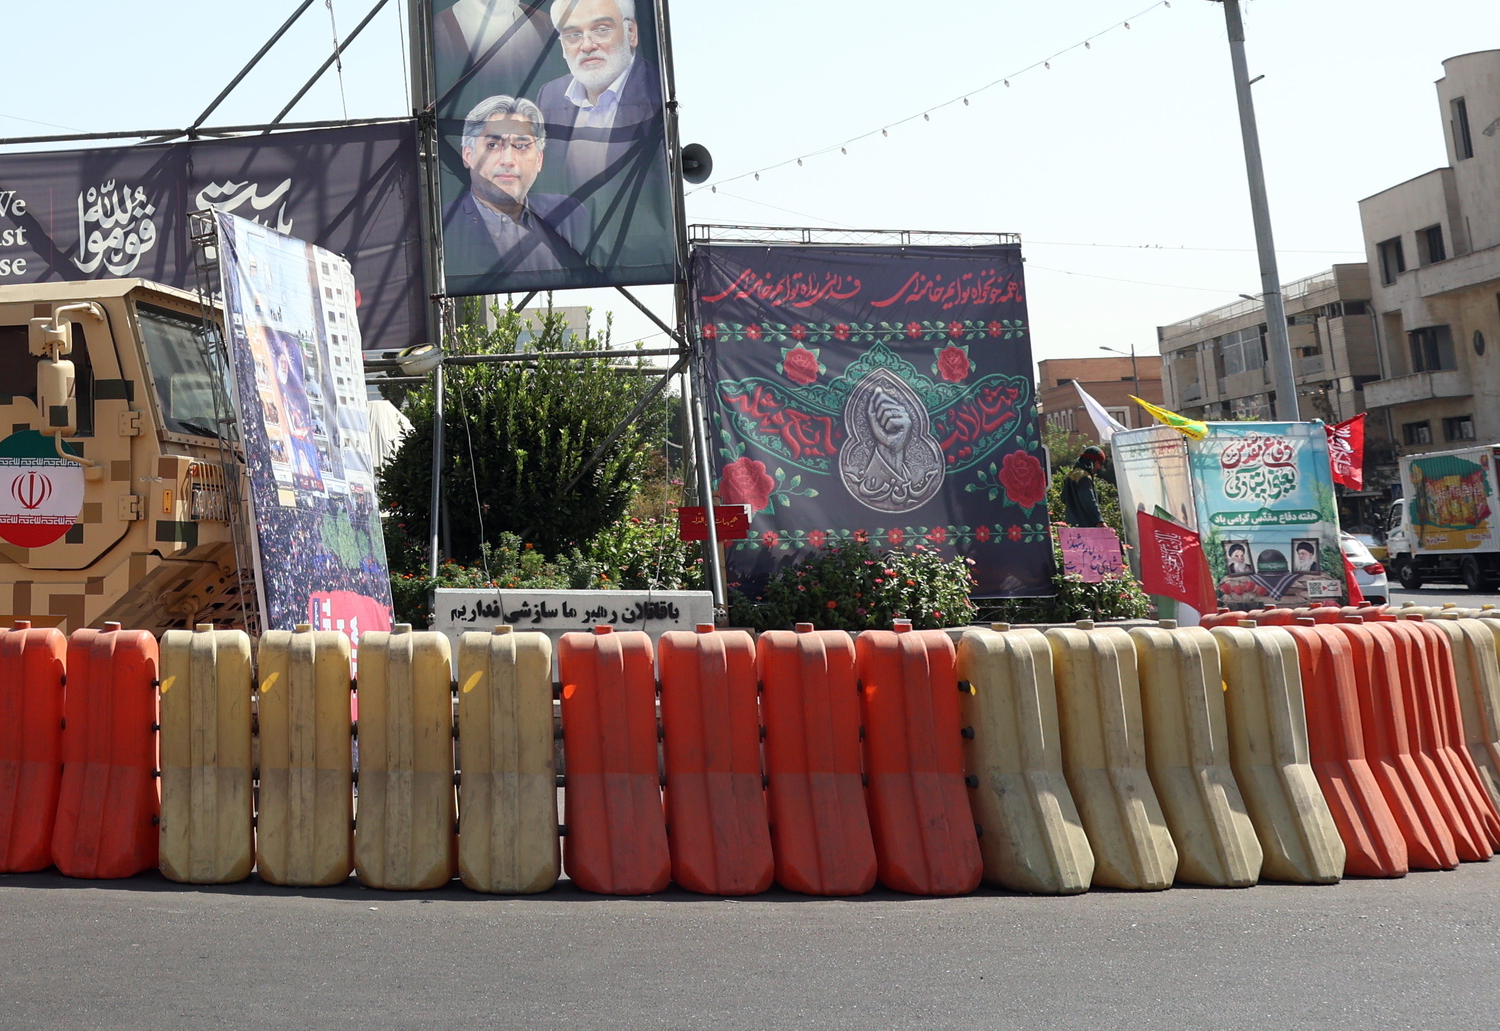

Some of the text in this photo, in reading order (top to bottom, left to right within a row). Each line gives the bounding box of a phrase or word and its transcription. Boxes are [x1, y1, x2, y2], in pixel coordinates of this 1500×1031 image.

[1214, 515, 1226, 525] باد
[1227, 513, 1250, 524] گرامی
[1279, 512, 1297, 523] دفاع
[1298, 512, 1318, 521] هفته
[451, 600, 500, 622] نداریم
[504, 601, 558, 623] سازشی
[562, 601, 577, 618] ما
[581, 605, 618, 623] رهبر
